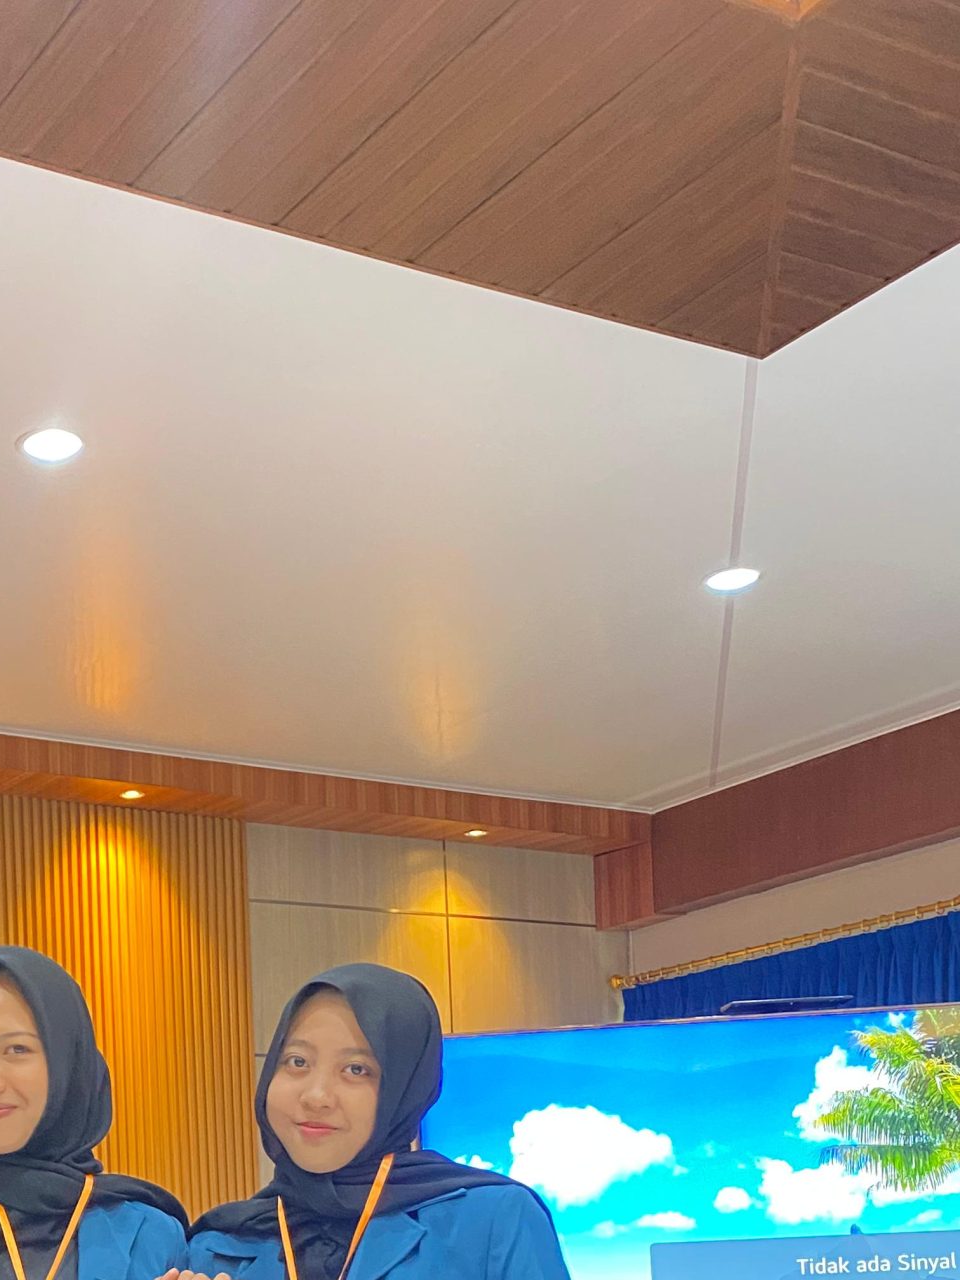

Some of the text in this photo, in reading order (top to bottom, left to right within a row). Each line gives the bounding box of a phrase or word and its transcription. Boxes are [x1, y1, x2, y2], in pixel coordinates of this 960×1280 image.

[796, 1251, 957, 1275] Tidak ada Sinyal
